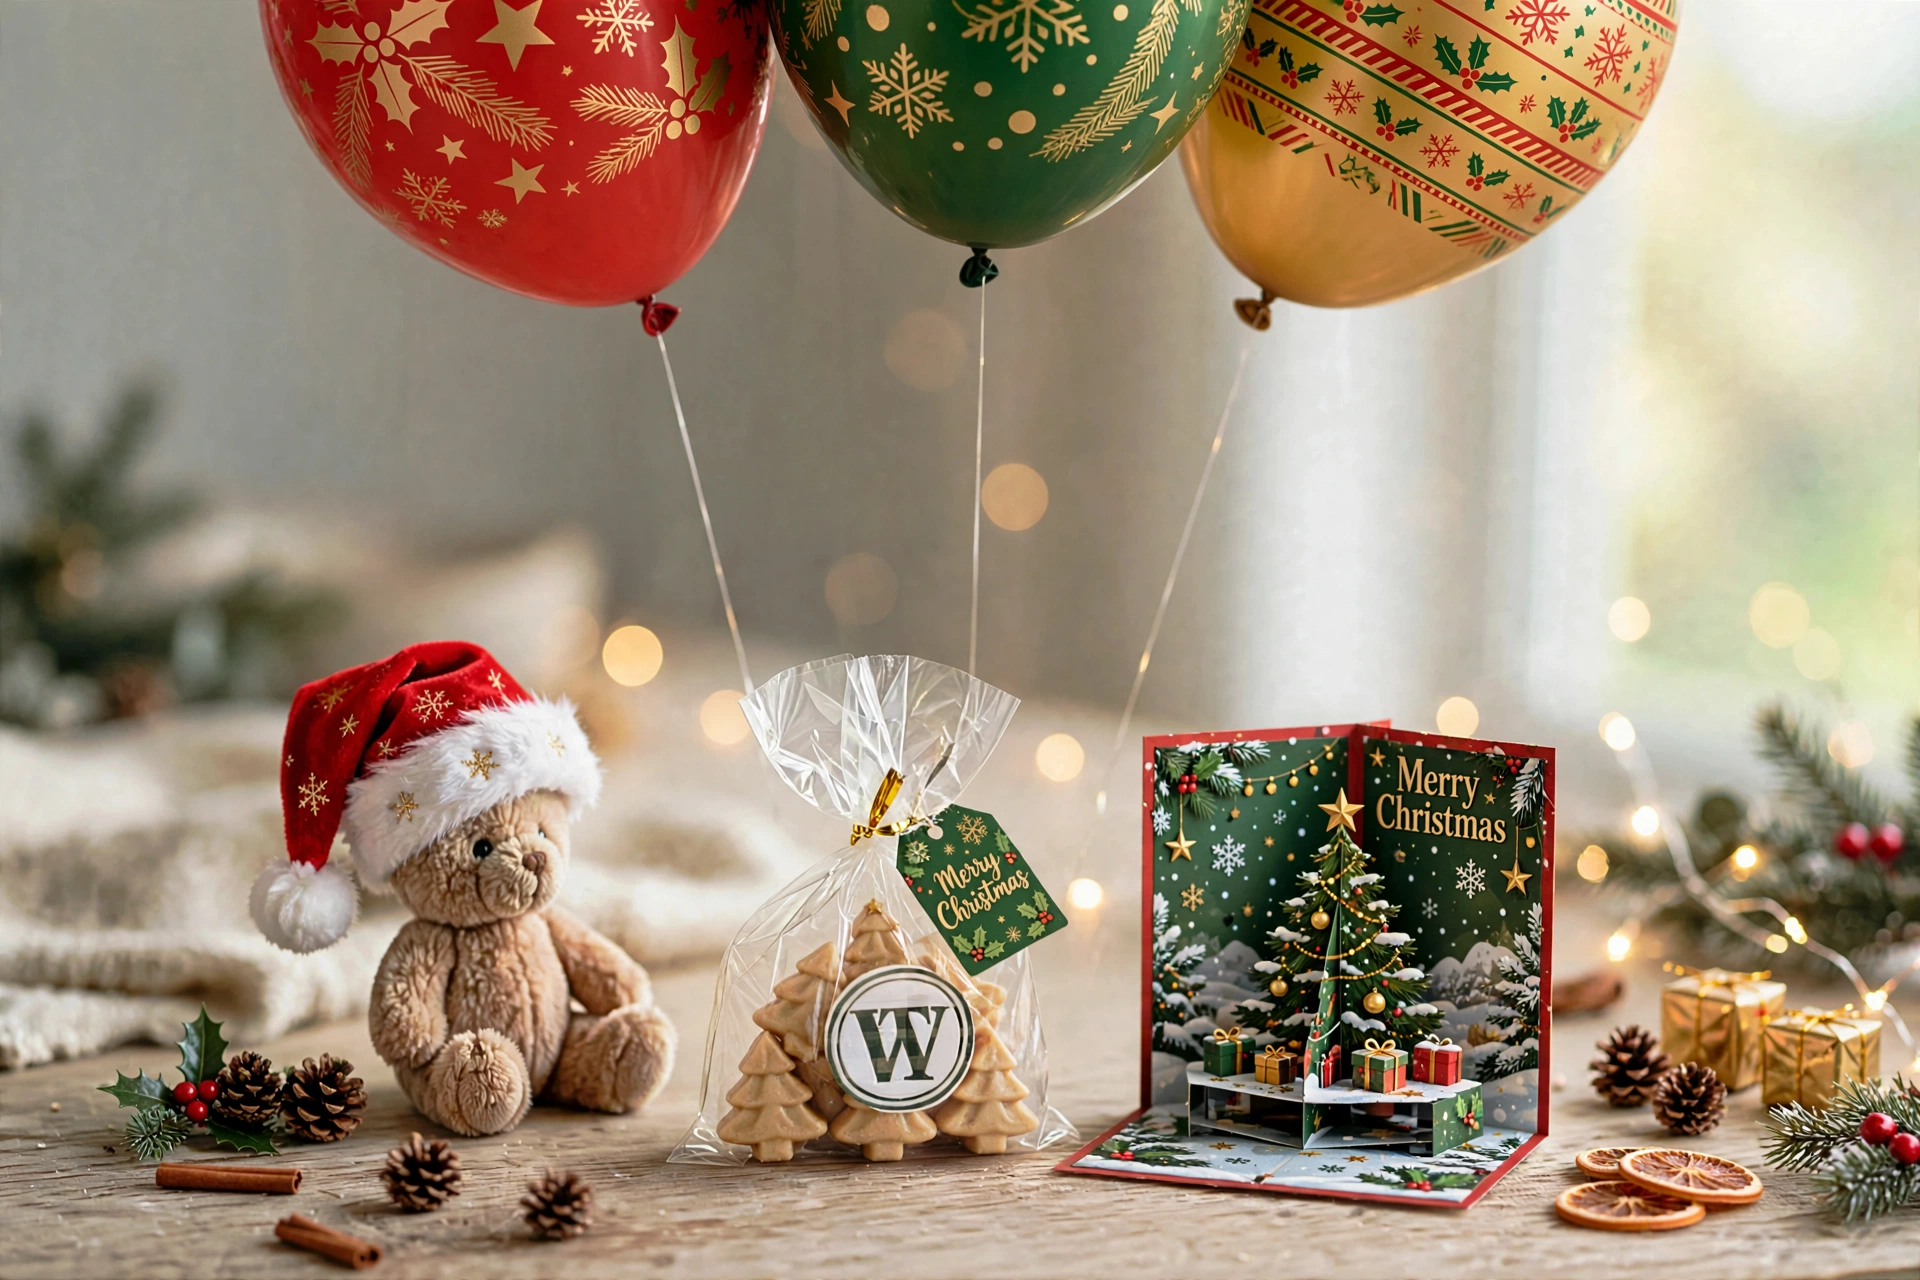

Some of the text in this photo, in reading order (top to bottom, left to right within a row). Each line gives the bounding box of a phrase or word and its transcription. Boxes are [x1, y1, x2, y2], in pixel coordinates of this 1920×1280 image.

[1397, 755, 1480, 809] Merry
[1376, 793, 1506, 843] Christmas
[933, 853, 1000, 896] Merry
[937, 870, 1029, 930] Christmas
